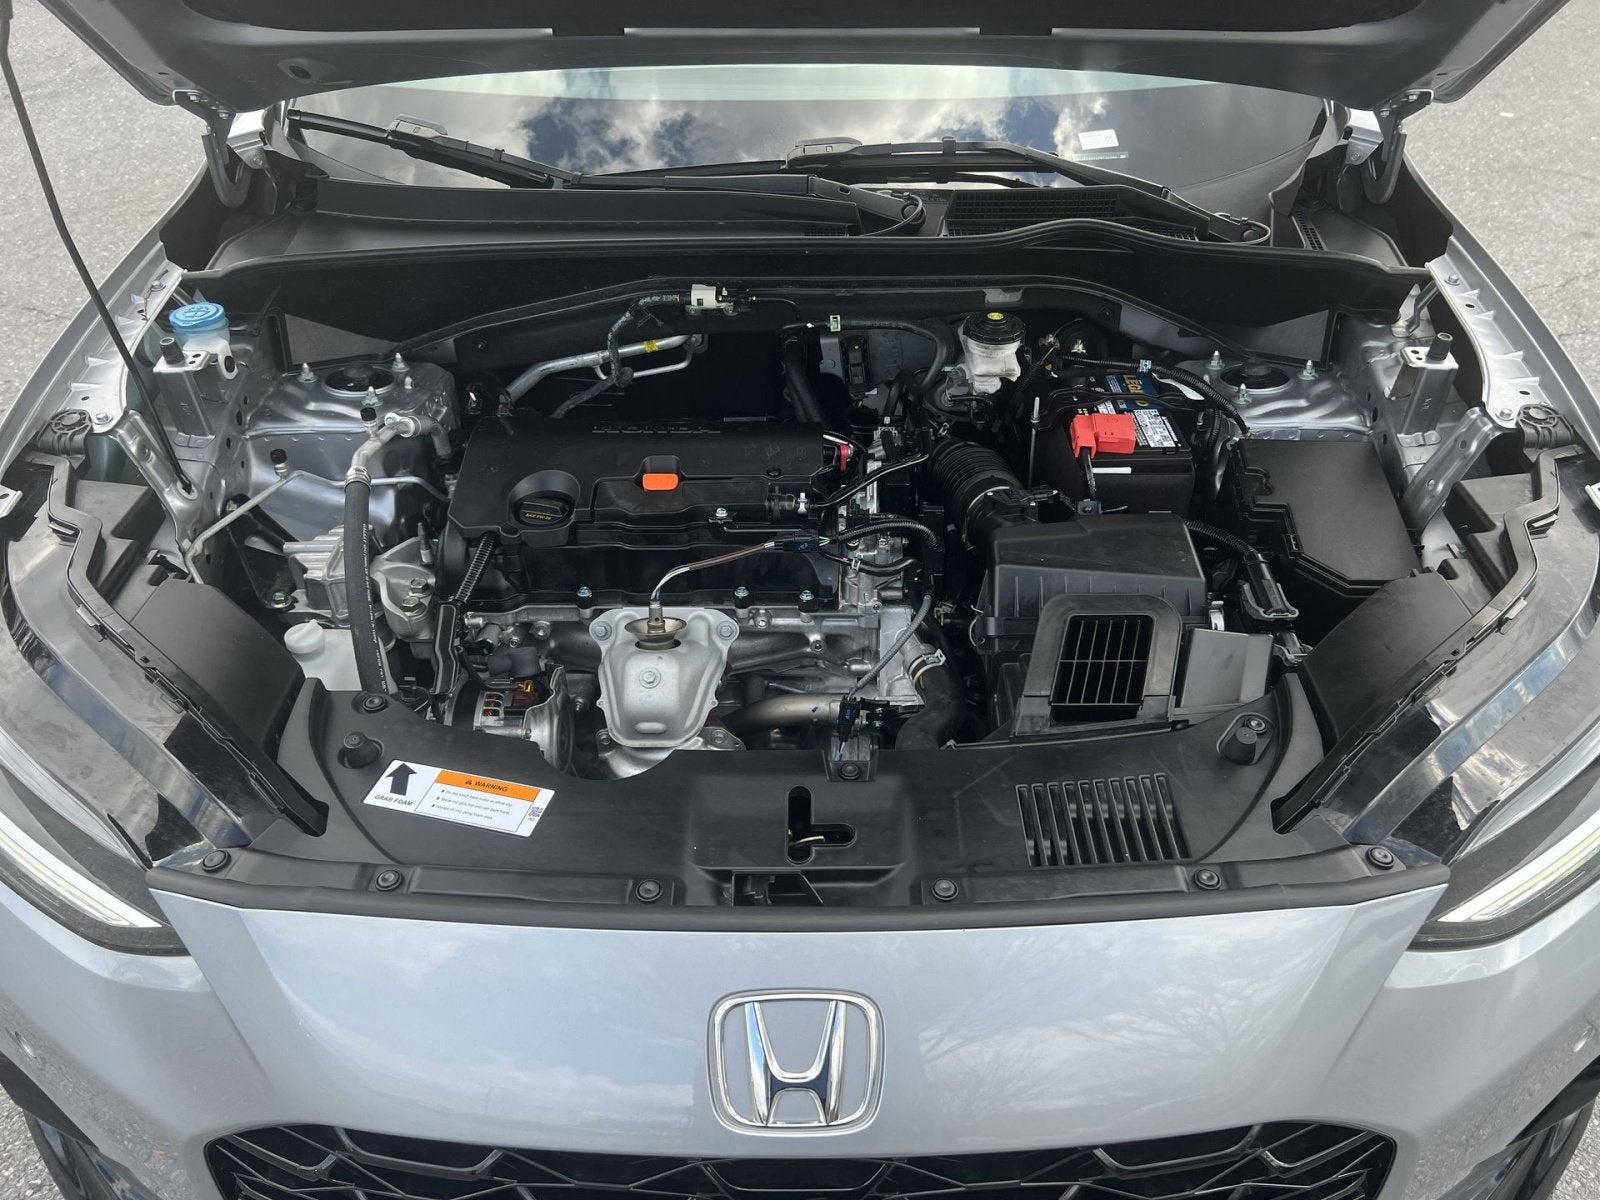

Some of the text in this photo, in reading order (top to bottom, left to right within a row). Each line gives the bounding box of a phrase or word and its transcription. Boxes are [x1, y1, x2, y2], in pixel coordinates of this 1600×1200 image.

[474, 780, 508, 792] WARNING
[374, 794, 413, 806] GRAB FOAM
